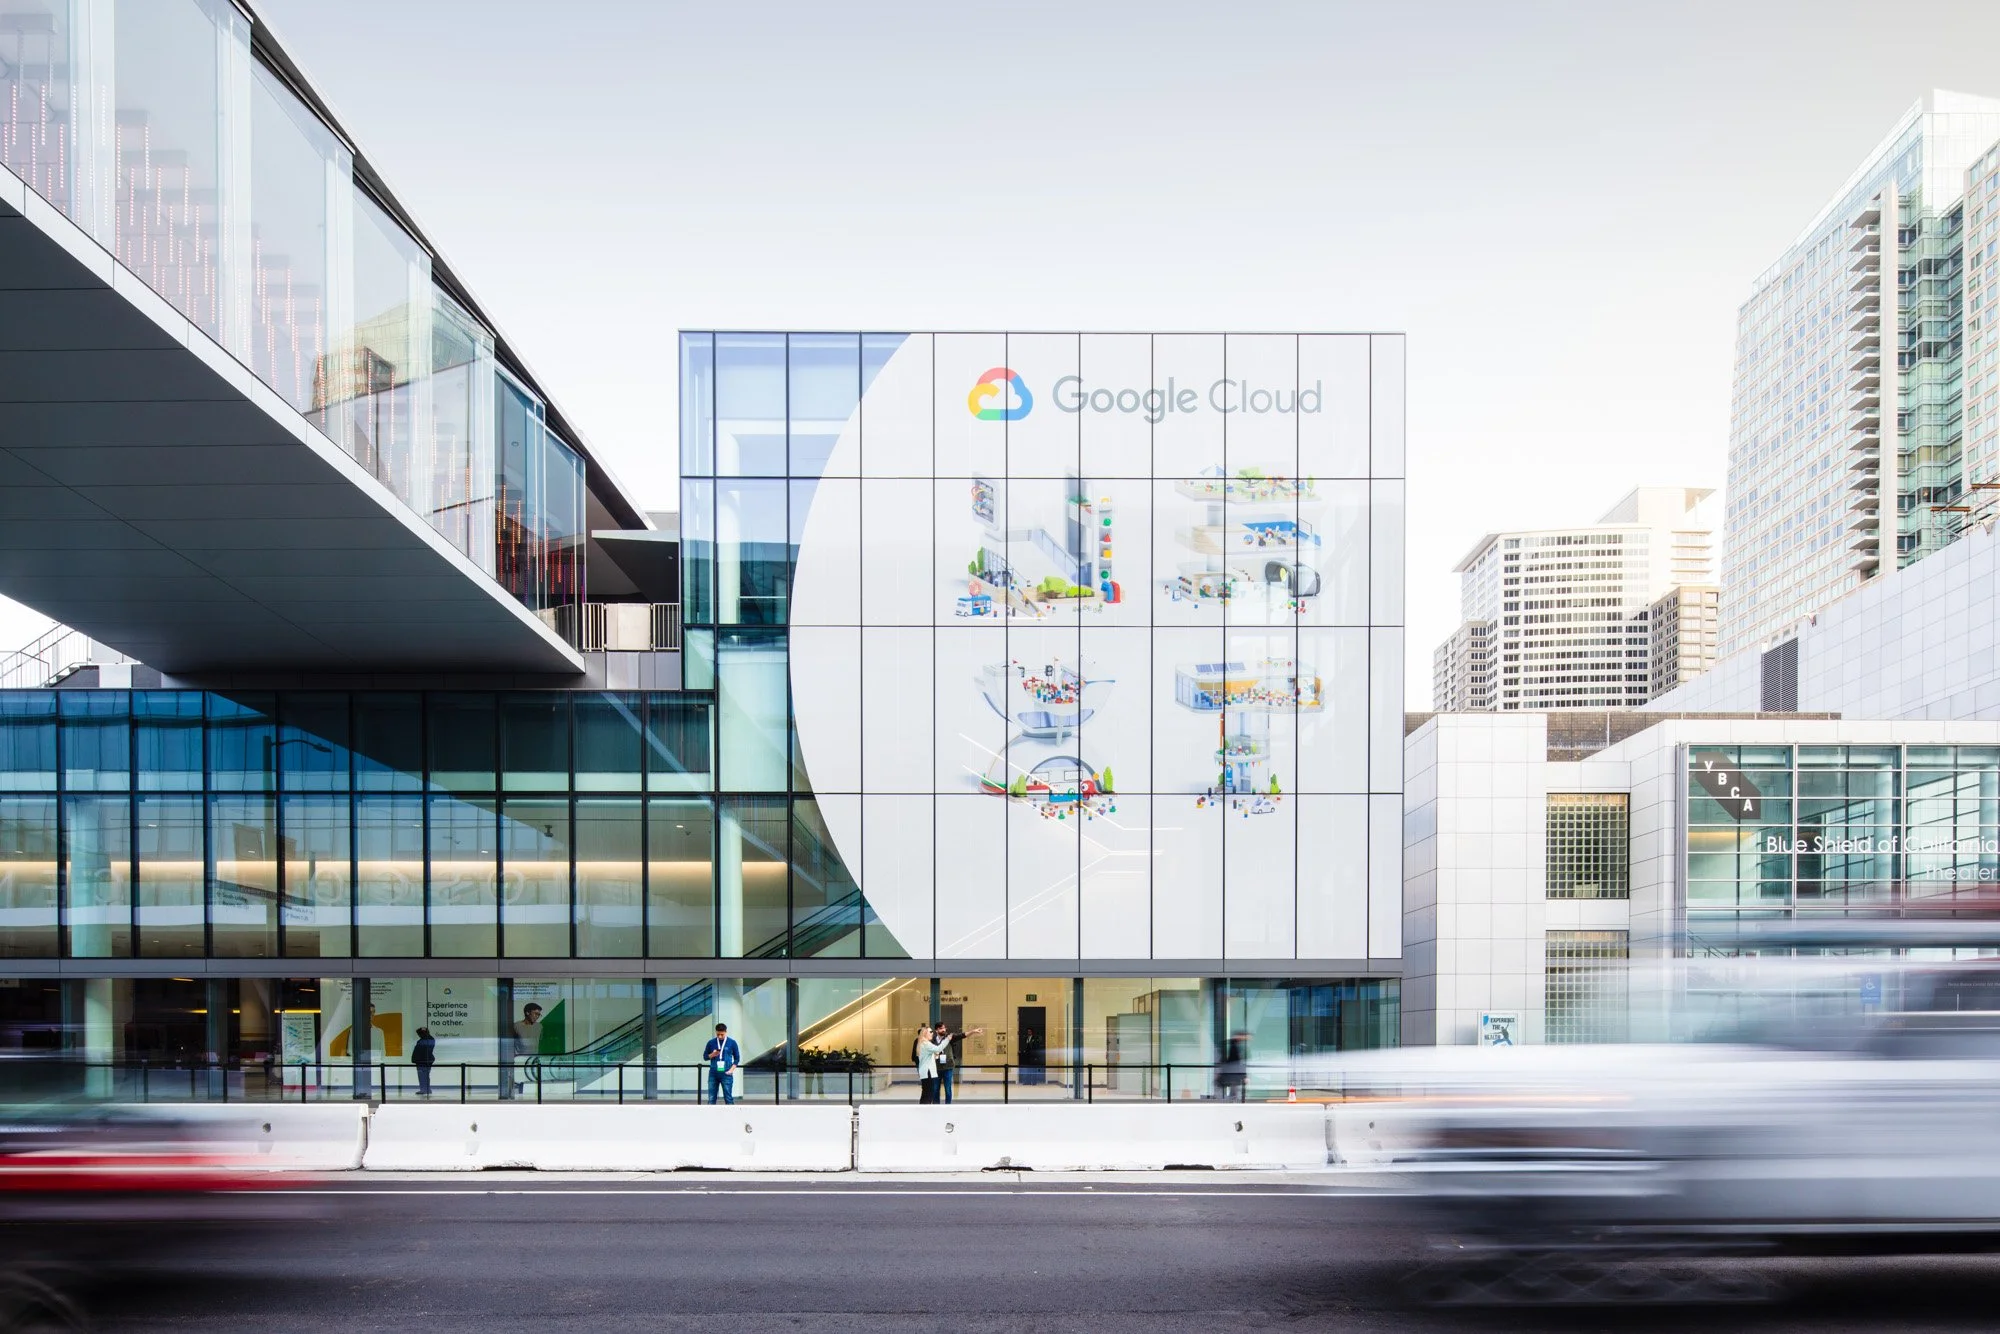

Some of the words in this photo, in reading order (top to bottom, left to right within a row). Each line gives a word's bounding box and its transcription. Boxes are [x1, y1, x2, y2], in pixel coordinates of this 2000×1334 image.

[1052, 375, 1199, 424] Google
[1208, 377, 1322, 414] Cloud
[1766, 837, 1808, 853] Blue
[1813, 836, 1873, 853] Shield
[1877, 836, 1899, 853] of
[1903, 836, 1999, 853] California
[1924, 864, 1998, 881] Theater
[427, 1002, 468, 1010] Experience
[433, 1010, 454, 1018] cloud
[455, 1010, 468, 1018] like
